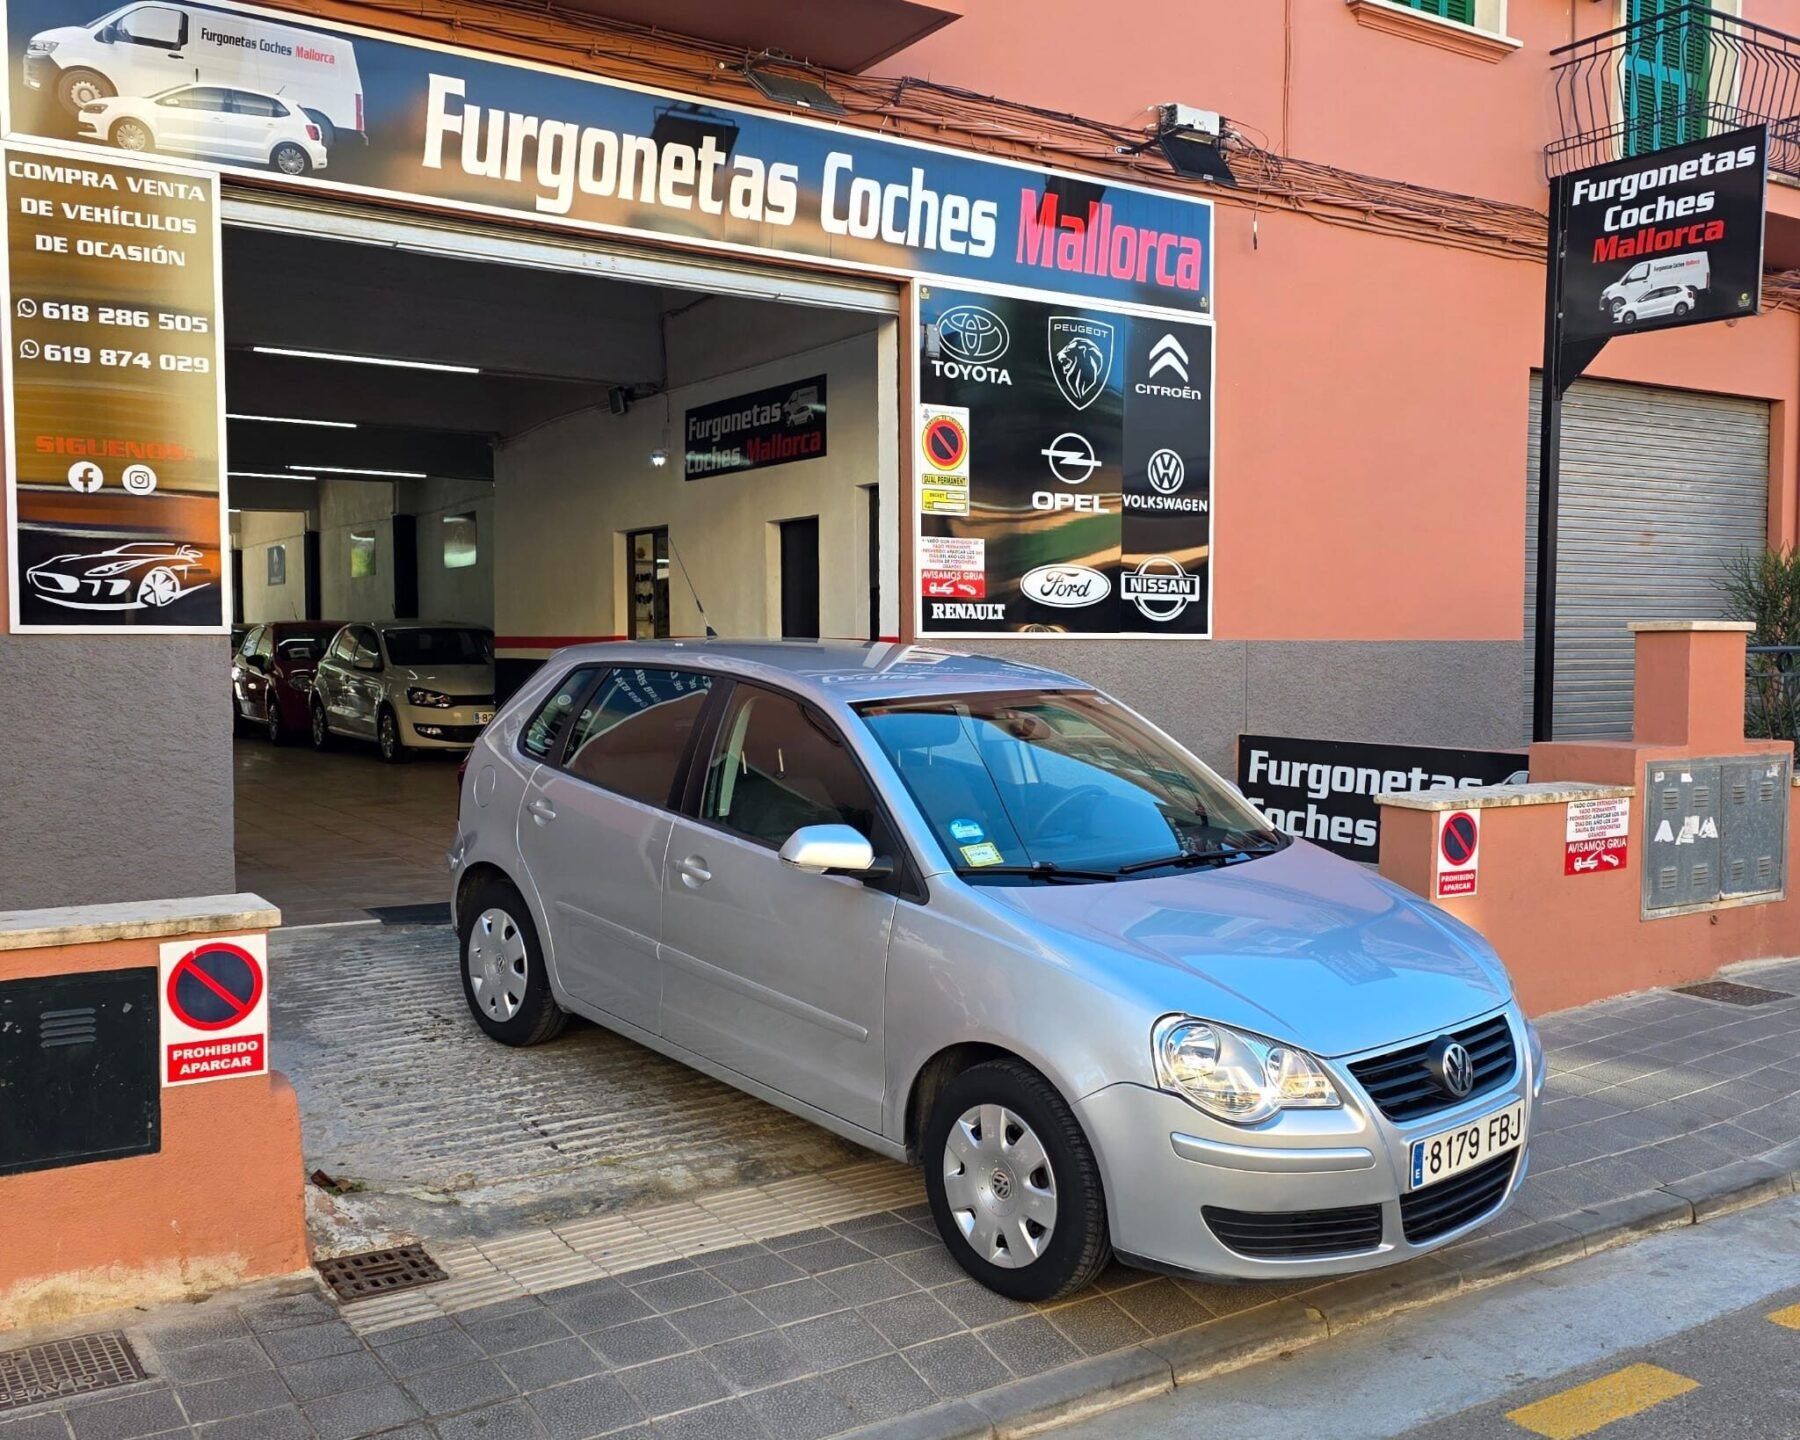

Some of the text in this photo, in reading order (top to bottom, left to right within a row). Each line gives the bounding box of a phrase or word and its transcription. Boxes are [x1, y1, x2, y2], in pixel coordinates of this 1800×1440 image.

[201, 27, 335, 64] Furgonetas Coches Mallorca
[8, 160, 207, 202] COMPRA VENTA
[421, 73, 1202, 291] Furgonetas Coches Mallorca
[1572, 145, 1757, 206] Furgonetas
[20, 197, 197, 234] DE VEHÍCULOS
[1604, 190, 1716, 232] Coches
[35, 234, 185, 266] DE OCASIÓN
[1592, 219, 1725, 264] Mallorca
[42, 301, 209, 333] 618 286 505
[1054, 323, 1110, 339] PEUGEOT
[44, 344, 210, 374] 619 874 029
[931, 360, 1013, 386] TOYOTA
[688, 402, 782, 443] Furgonetas
[686, 431, 822, 474] Coches Mallorca
[1031, 491, 1110, 514] OPEL
[1122, 494, 1208, 513] VOLKSWAGEN
[922, 571, 961, 580] AVISAMOS
[1040, 570, 1092, 598] Ford
[1130, 578, 1191, 594] NISSAN
[931, 603, 1006, 620] RENAULT
[1248, 797, 1377, 846] oches
[1568, 839, 1606, 854] AVISAMOS
[1441, 873, 1474, 882] PROHIBIDO
[1443, 882, 1471, 892] APARCAR
[172, 1040, 258, 1061] PROHIBIDO
[180, 1055, 252, 1075] APARCAR
[1430, 1108, 1521, 1174] 8179 FBJ
